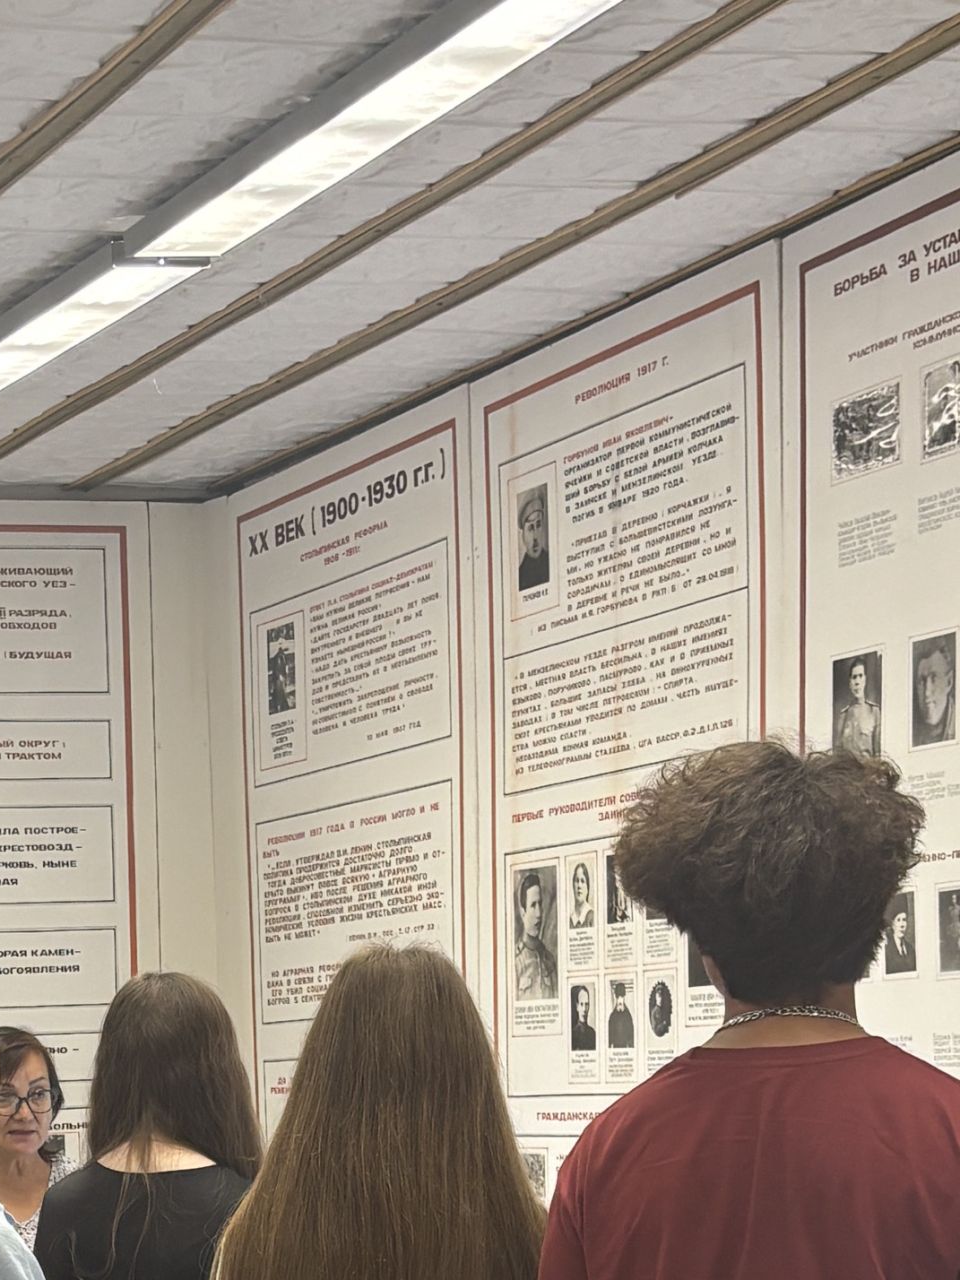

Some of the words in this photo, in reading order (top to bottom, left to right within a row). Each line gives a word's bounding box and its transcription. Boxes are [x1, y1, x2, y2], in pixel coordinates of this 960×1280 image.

[834, 264, 887, 297] БОРЬБА
[898, 250, 917, 269] ЗА
[910, 268, 920, 283] В
[574, 371, 630, 407] РЕВОЛЮЦИЯ
[637, 359, 657, 378] 1917
[564, 451, 612, 477] ОРГАНИЗАТОР
[616, 437, 644, 455] ПЕРВОЙ
[649, 401, 731, 443] КОММУНИСТИЧЕСКОЙ
[583, 478, 610, 495] БОРЬБУ
[624, 462, 647, 479] БЕЛОЙ
[688, 434, 723, 455] КОЛЧАКА
[605, 448, 648, 473] СОВЕТСКОЙ
[248, 528, 268, 558] XX
[274, 513, 304, 549] ВЕК
[1, 622, 57, 631] ОБХОДОВ
[5, 751, 62, 760] ТРАКТОМ
[512, 809, 544, 823] ПЕРВЫЕ
[549, 796, 616, 817] РУКОВОДИТЕЛИ
[24, 826, 86, 835] ПОСТРОЕ-
[42, 860, 77, 868] НЫНЕ
[30, 949, 81, 957] КАМЕН-
